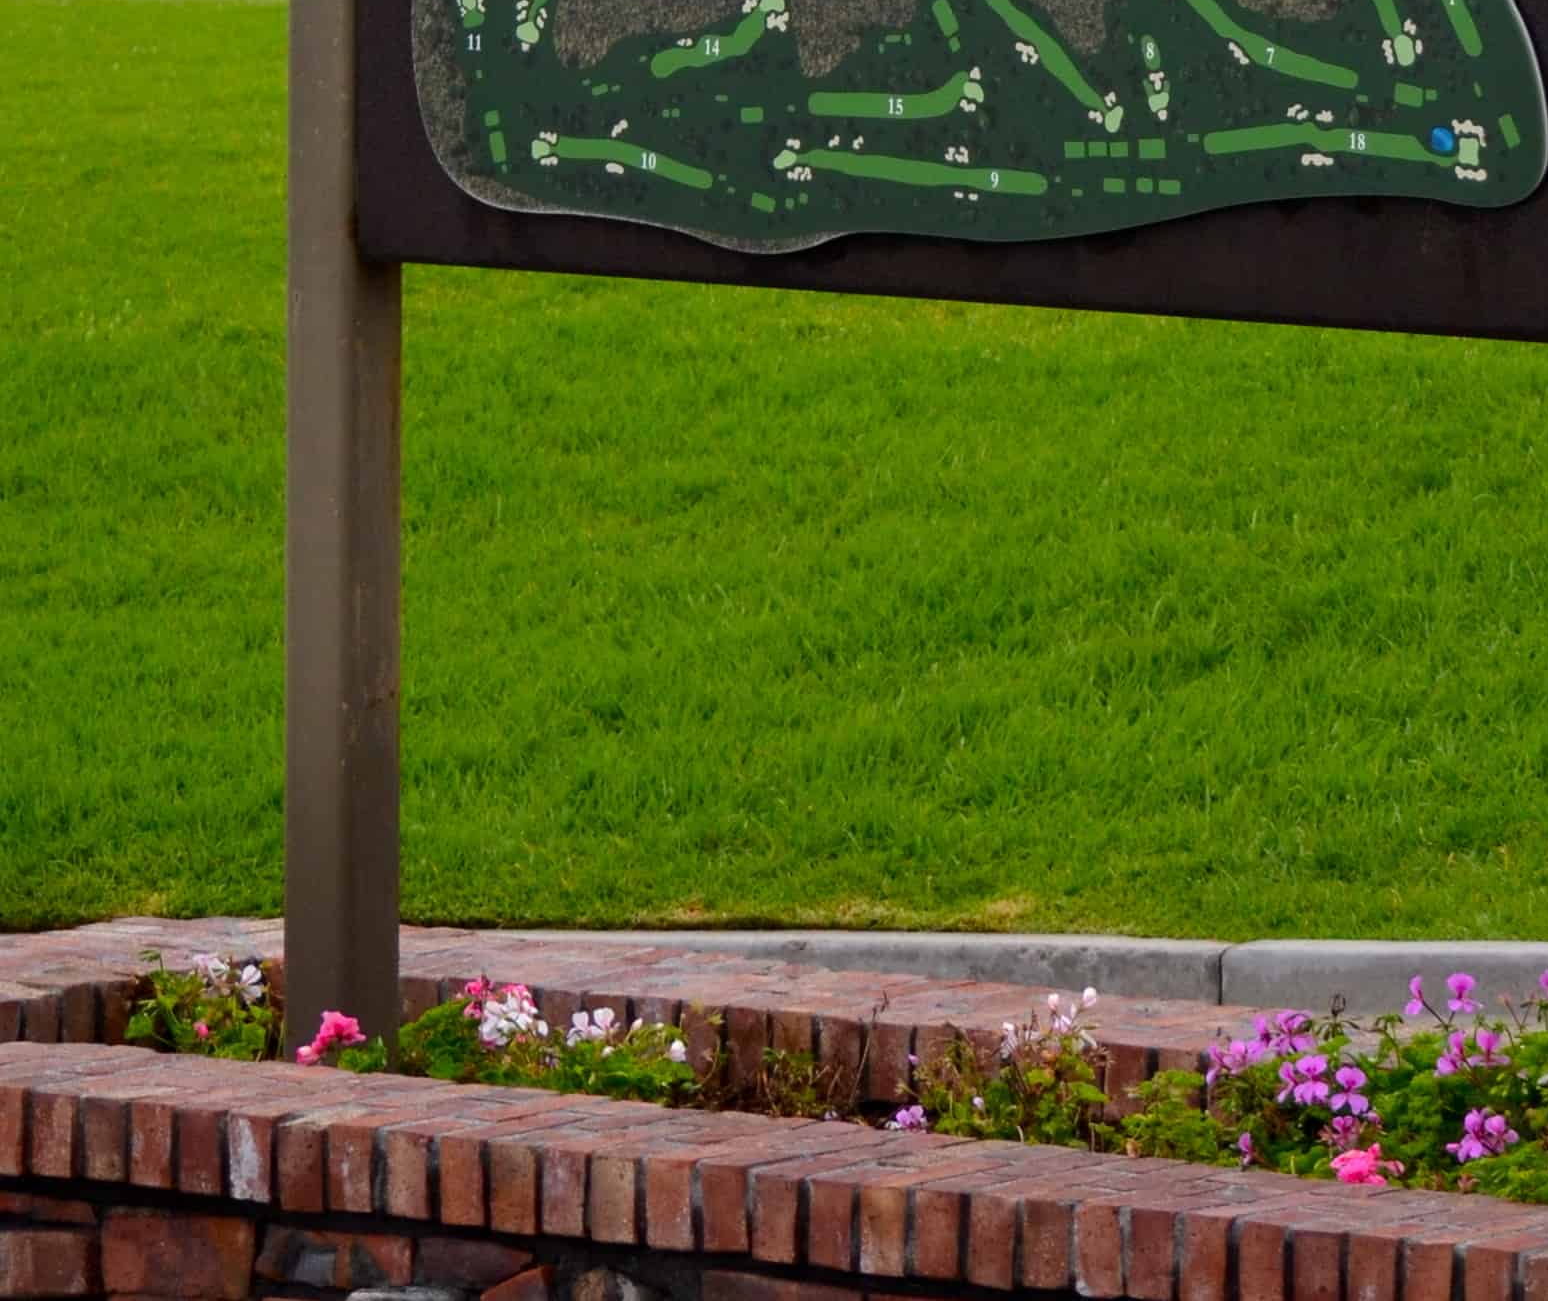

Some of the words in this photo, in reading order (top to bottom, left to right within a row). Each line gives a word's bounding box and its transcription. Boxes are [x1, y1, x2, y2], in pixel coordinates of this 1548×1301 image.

[466, 33, 482, 51] 11
[704, 38, 720, 56] 14
[1145, 41, 1155, 59] 8
[1265, 47, 1274, 65] 7
[888, 97, 904, 114] 15
[1349, 132, 1366, 149] 18
[640, 152, 657, 170] 10
[990, 171, 999, 188] 9
